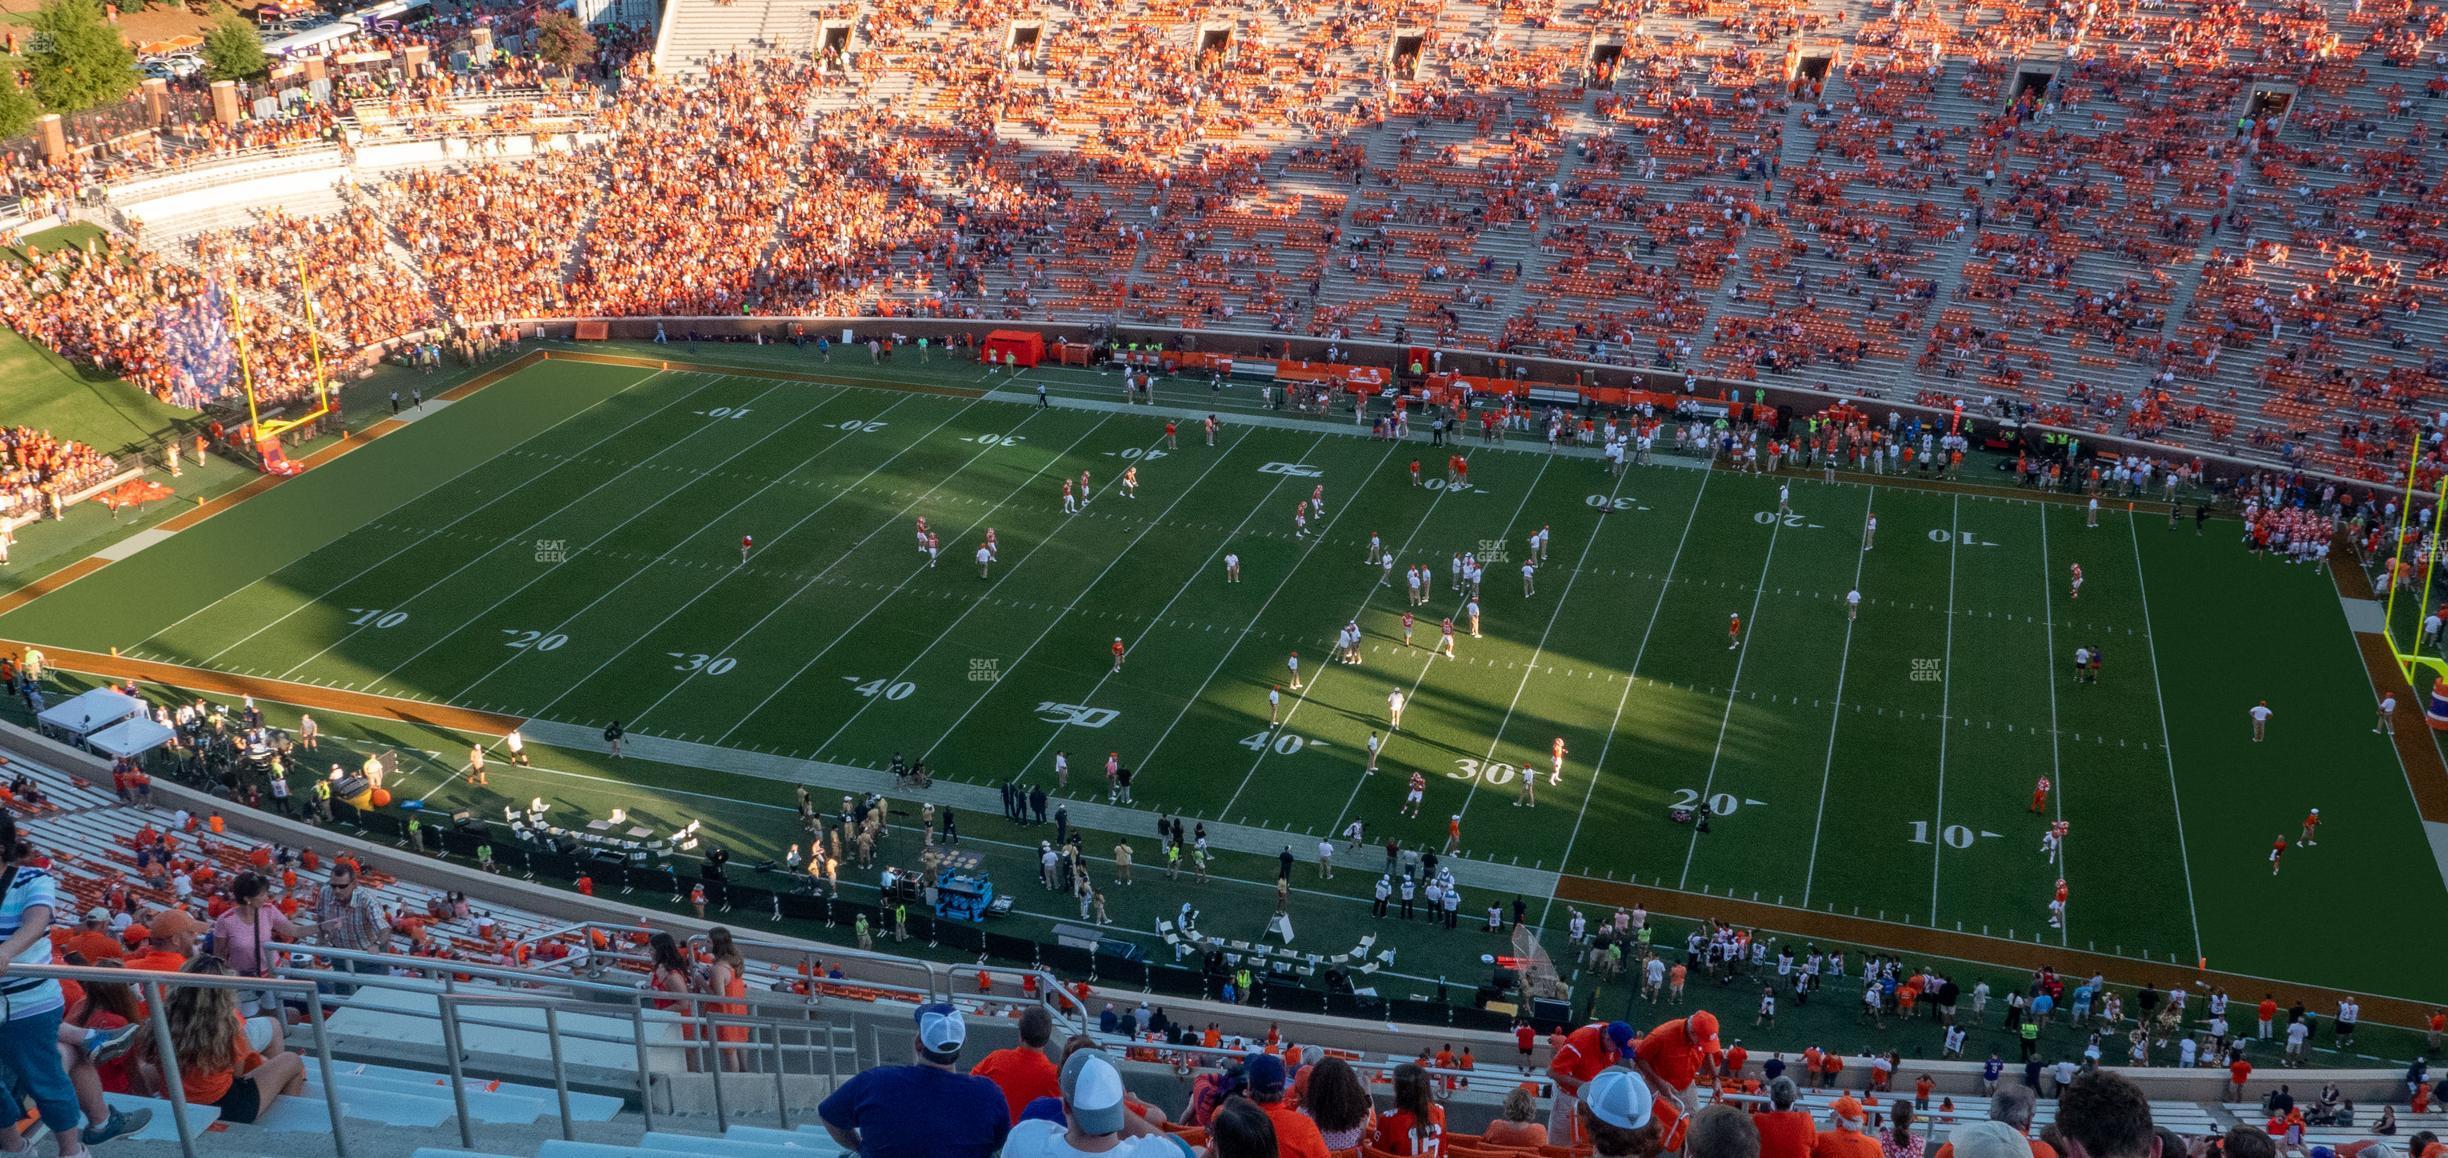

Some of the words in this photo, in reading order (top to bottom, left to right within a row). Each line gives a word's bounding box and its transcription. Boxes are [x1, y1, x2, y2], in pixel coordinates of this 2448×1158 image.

[708, 407, 754, 419] 10
[840, 420, 888, 432] 20
[977, 433, 1026, 446] 30
[1120, 447, 1168, 461] 40
[1586, 494, 1636, 508] 30
[1754, 511, 1806, 526] 20
[1928, 529, 1978, 545] 10
[347, 610, 408, 628] 10
[505, 630, 568, 651] 20
[674, 654, 737, 675] 30
[854, 678, 916, 700] 40
[1239, 731, 1304, 755] 40
[1446, 758, 1515, 784] 30
[1667, 788, 1738, 816] 20
[1907, 821, 1974, 849] 10
